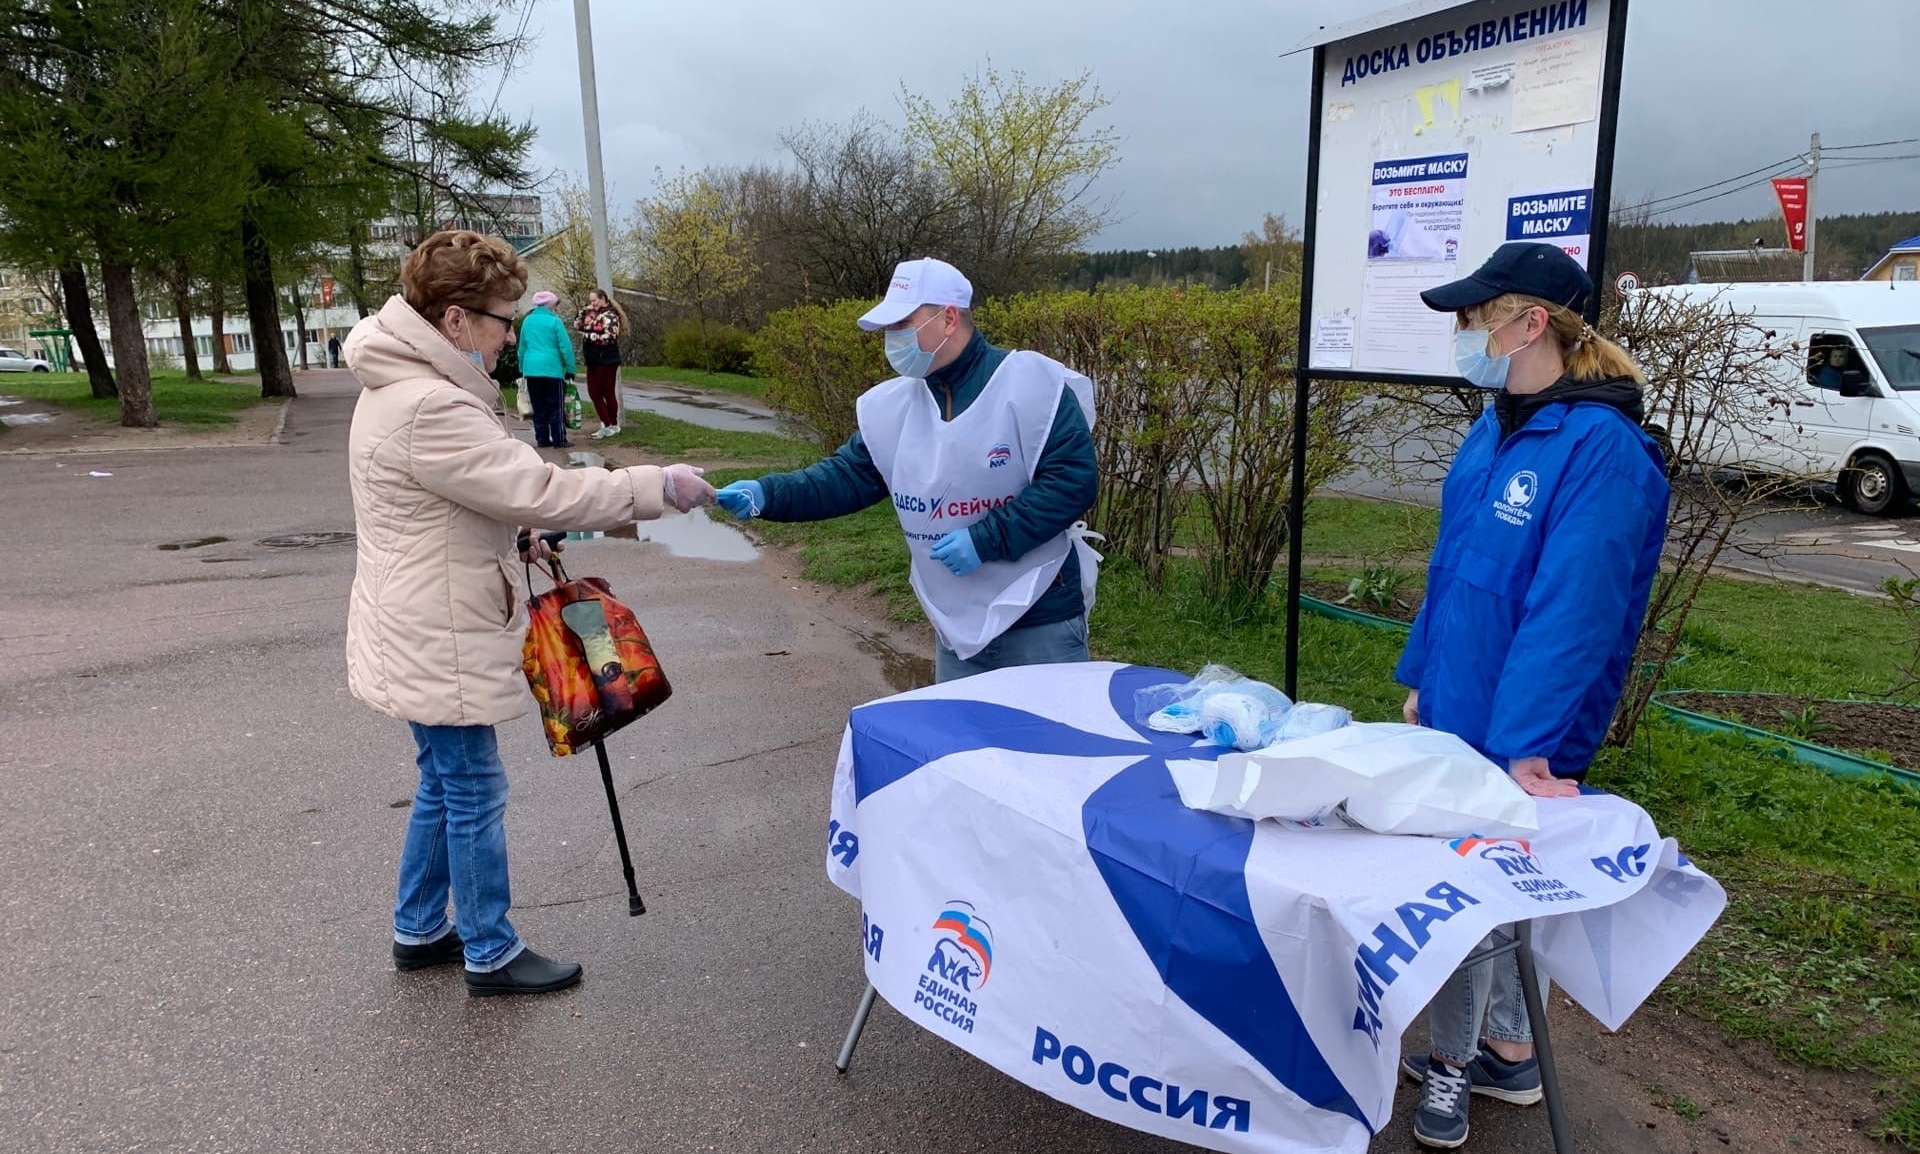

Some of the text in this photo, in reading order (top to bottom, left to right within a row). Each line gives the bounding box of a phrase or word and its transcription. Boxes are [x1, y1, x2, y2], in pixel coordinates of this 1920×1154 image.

[1341, 43, 1410, 87] ДОСКА
[1374, 159, 1467, 180] ВОЗЬМИТЕ МАСКУ
[1389, 185, 1445, 197] ЭТО БЕСПЛАТНО
[1512, 195, 1587, 217] ВОЗЬМИТЕ
[1522, 217, 1572, 235] МАСКУ
[1795, 222, 1803, 234] 9
[1621, 279, 1634, 291] 40
[894, 492, 926, 513] ЗДЕСЬ
[1512, 879, 1569, 893] ЕДИНАЯ
[918, 974, 978, 1017] ЕДИНАЯ
[914, 990, 975, 1034] РОССИЯ
[1032, 1025, 1251, 1133] РОССИЯ
